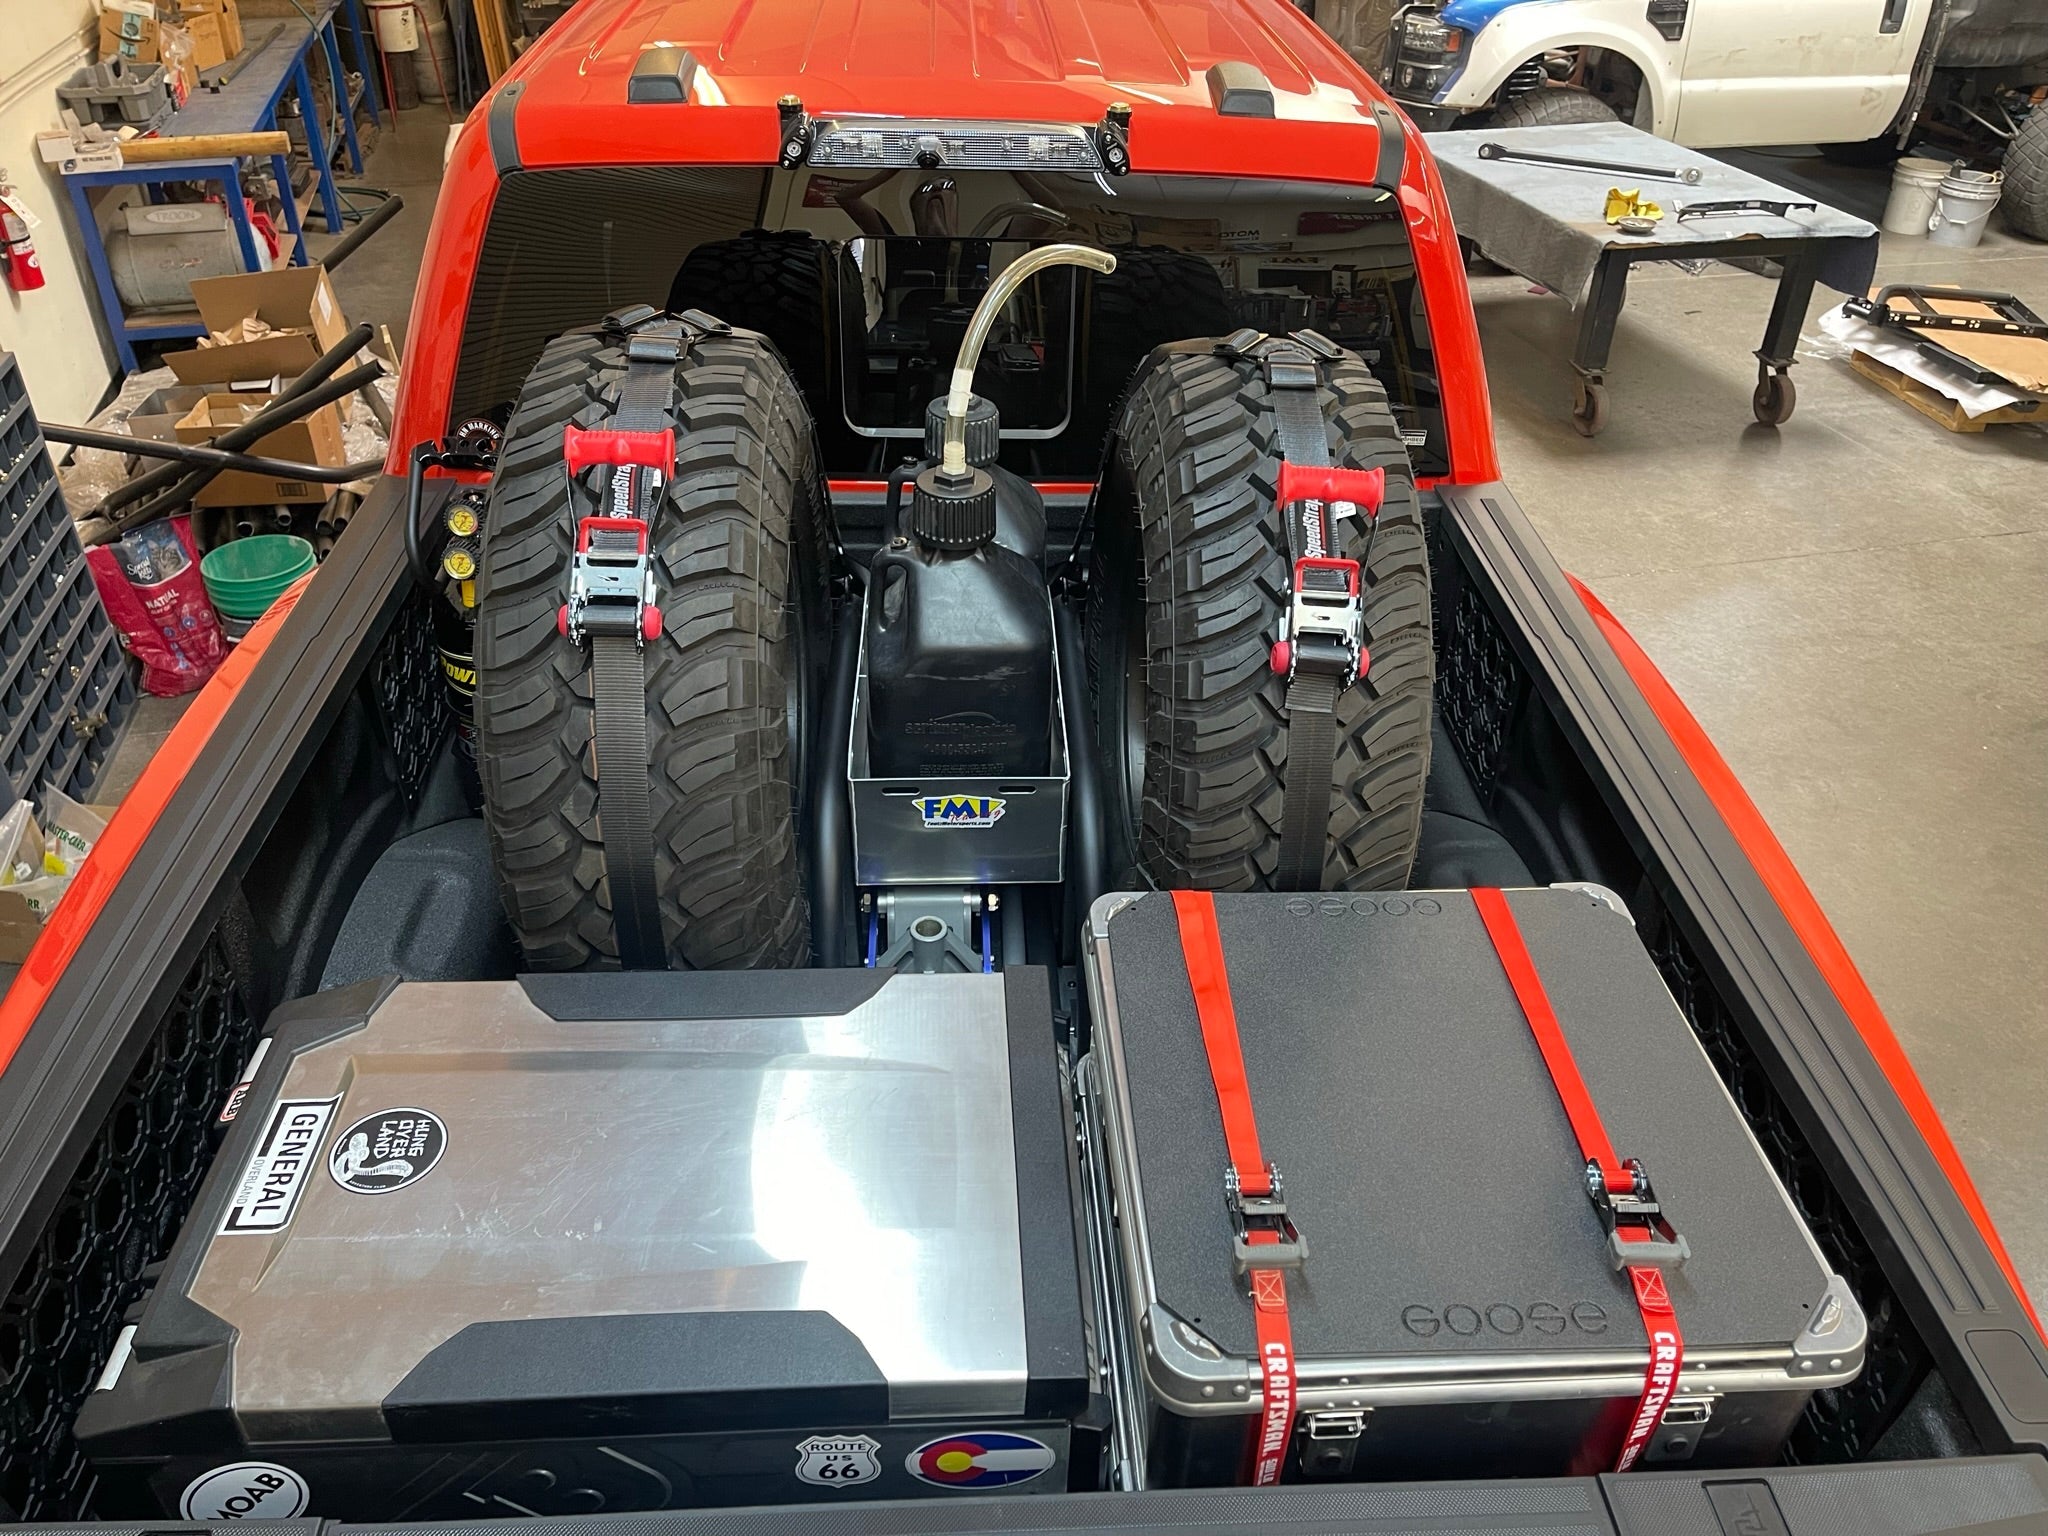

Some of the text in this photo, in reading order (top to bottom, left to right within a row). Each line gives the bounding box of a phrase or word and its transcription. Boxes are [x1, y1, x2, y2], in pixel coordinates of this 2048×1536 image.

[467, 422, 500, 439] MARKING
[924, 799, 991, 819] FMI
[373, 1120, 399, 1159] LAND
[388, 1120, 415, 1159] OVER
[407, 1120, 432, 1157] HUNG
[236, 1159, 266, 1205] OVERLAND
[251, 1113, 320, 1217] GENERAL
[1262, 1343, 1290, 1456] CRAFTSMAN
[1629, 1331, 1677, 1444] CRAFTSMAN
[810, 1443, 867, 1451] ROUTE
[818, 1463, 861, 1480] 66
